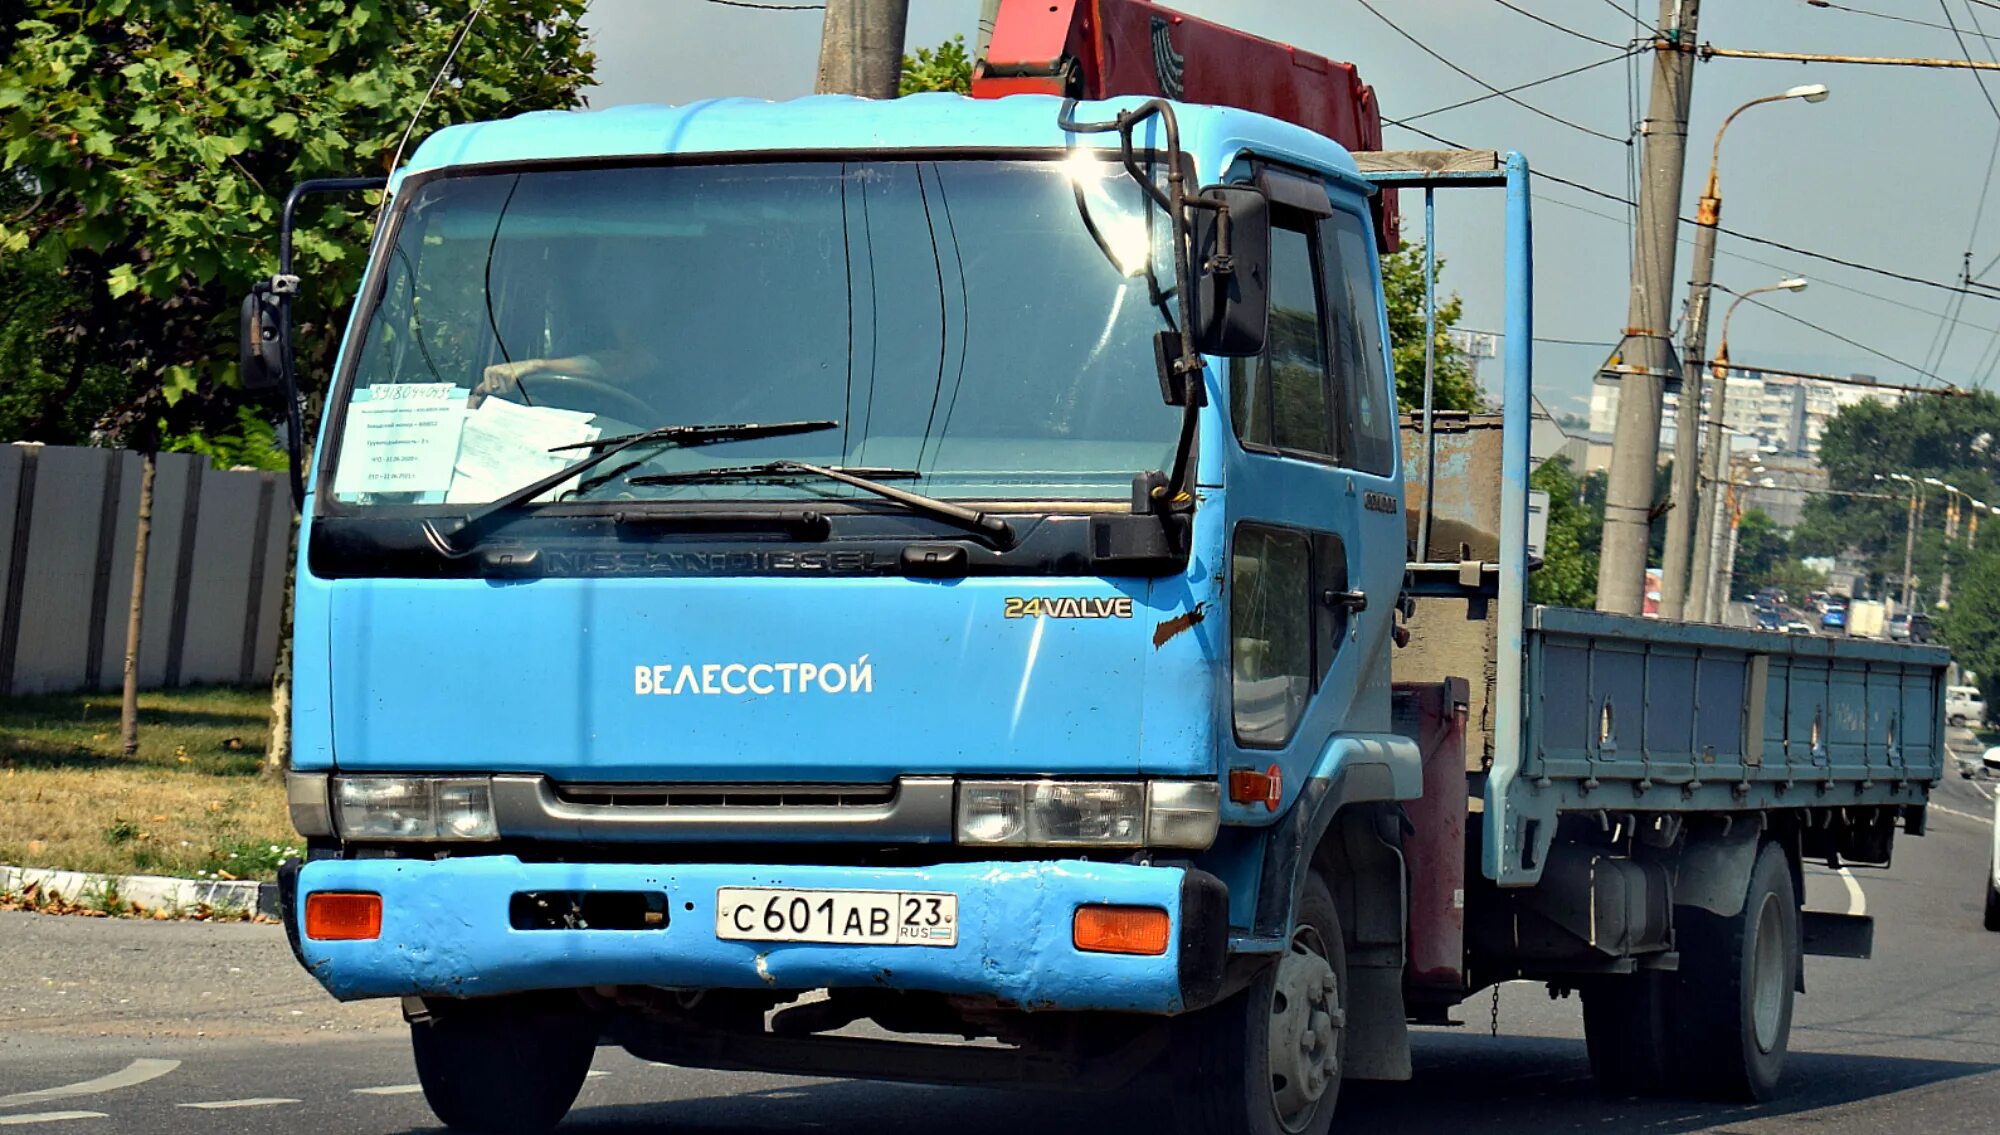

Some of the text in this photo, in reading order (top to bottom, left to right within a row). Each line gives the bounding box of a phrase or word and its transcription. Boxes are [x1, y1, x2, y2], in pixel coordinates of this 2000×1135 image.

[635, 653, 873, 695] ВЕЛЕССТРОЙ
[904, 898, 941, 926] 23
[900, 927, 929, 939] RUS
